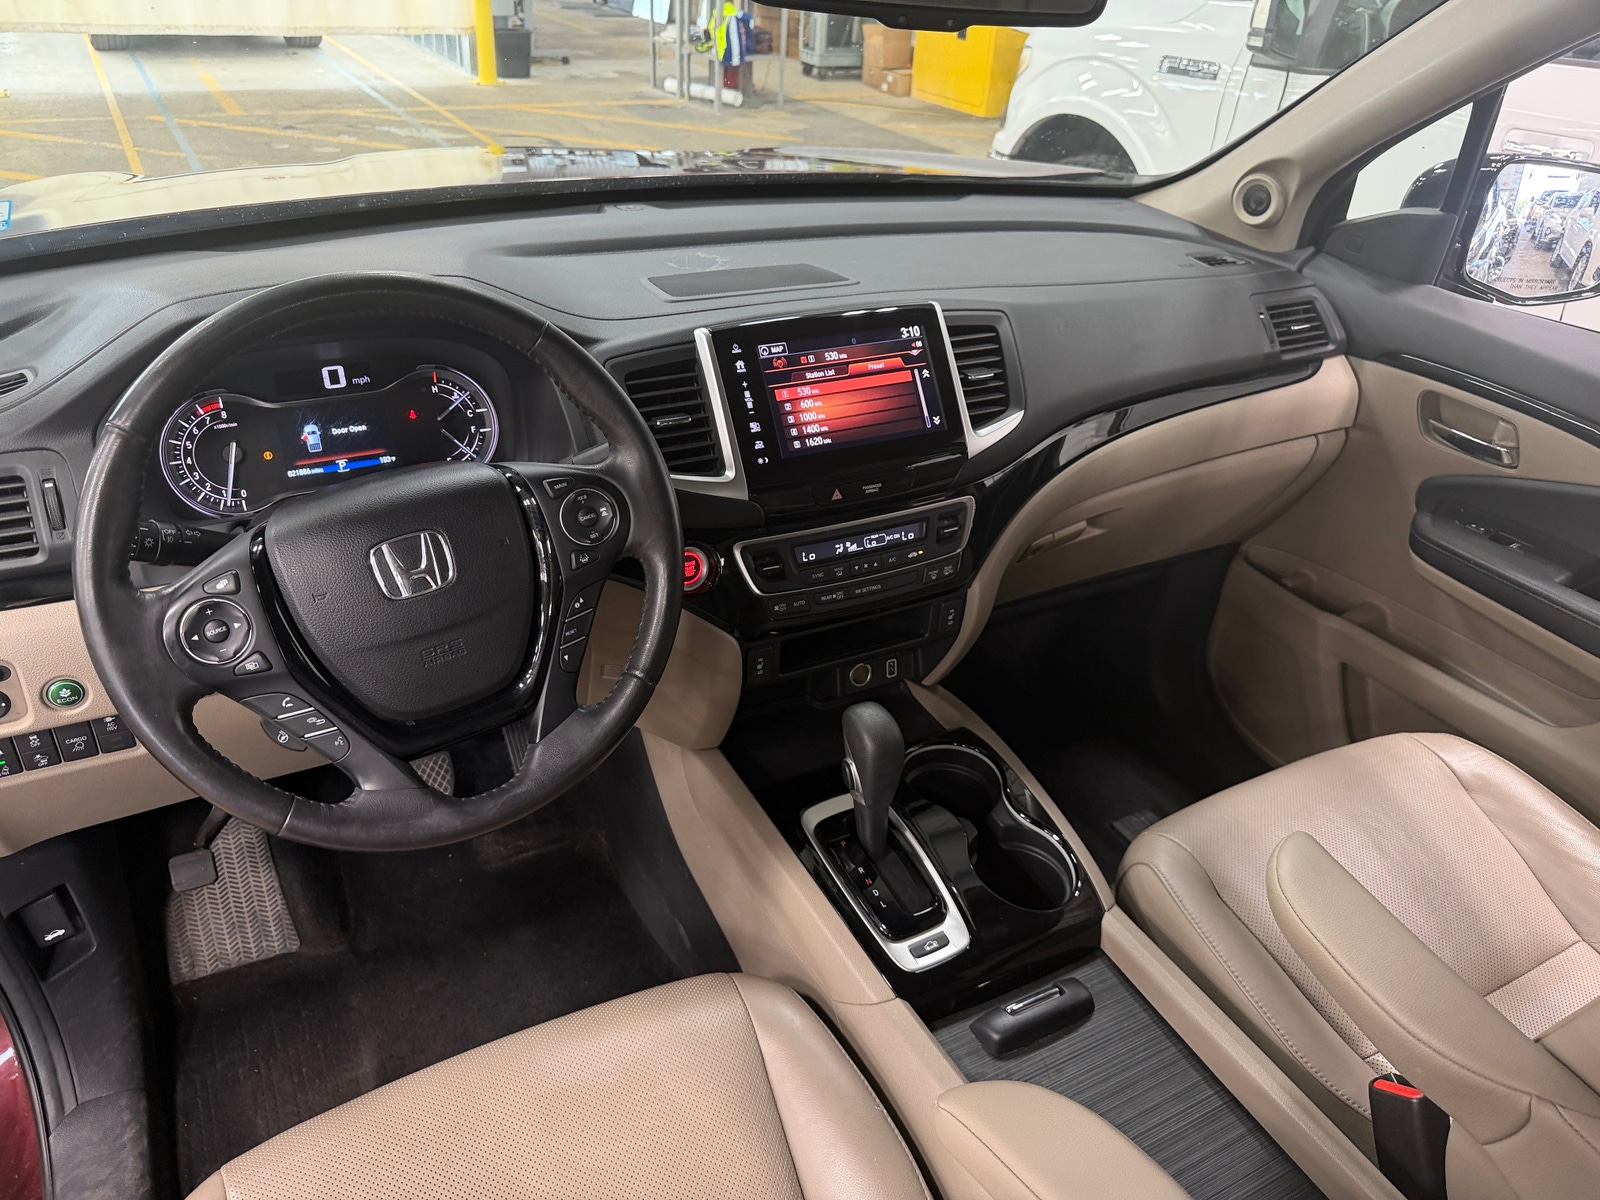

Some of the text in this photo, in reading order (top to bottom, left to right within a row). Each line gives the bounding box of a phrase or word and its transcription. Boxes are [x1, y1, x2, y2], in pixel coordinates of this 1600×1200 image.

[900, 325, 920, 338] 3:10
[825, 351, 838, 360] 530
[868, 362, 885, 370] Preset
[322, 365, 371, 389] 0 mph
[805, 371, 824, 379] Station
[431, 385, 438, 393] H
[797, 387, 811, 396] 530
[800, 399, 814, 408] 600
[221, 411, 227, 419] 8
[467, 409, 474, 417] C
[799, 412, 817, 421] 1000
[205, 416, 210, 424] 7
[193, 426, 199, 434] 6
[331, 424, 367, 435] Door Open
[470, 425, 476, 433] F
[802, 424, 820, 434] 1400
[186, 441, 192, 449] 5
[805, 436, 823, 447] 1620
[186, 457, 192, 465] 4
[339, 460, 346, 471] P
[193, 472, 199, 480] 3
[205, 482, 212, 491] 2
[221, 489, 227, 497] 1
[241, 489, 247, 498] 0
[580, 512, 596, 522] CANCEL
[862, 584, 882, 593] SETTINGS
[206, 625, 227, 636] SOURCE
[565, 628, 577, 636] RESET
[56, 695, 78, 704] ECON
[65, 735, 87, 745] CARGO
[880, 900, 887, 908] L
